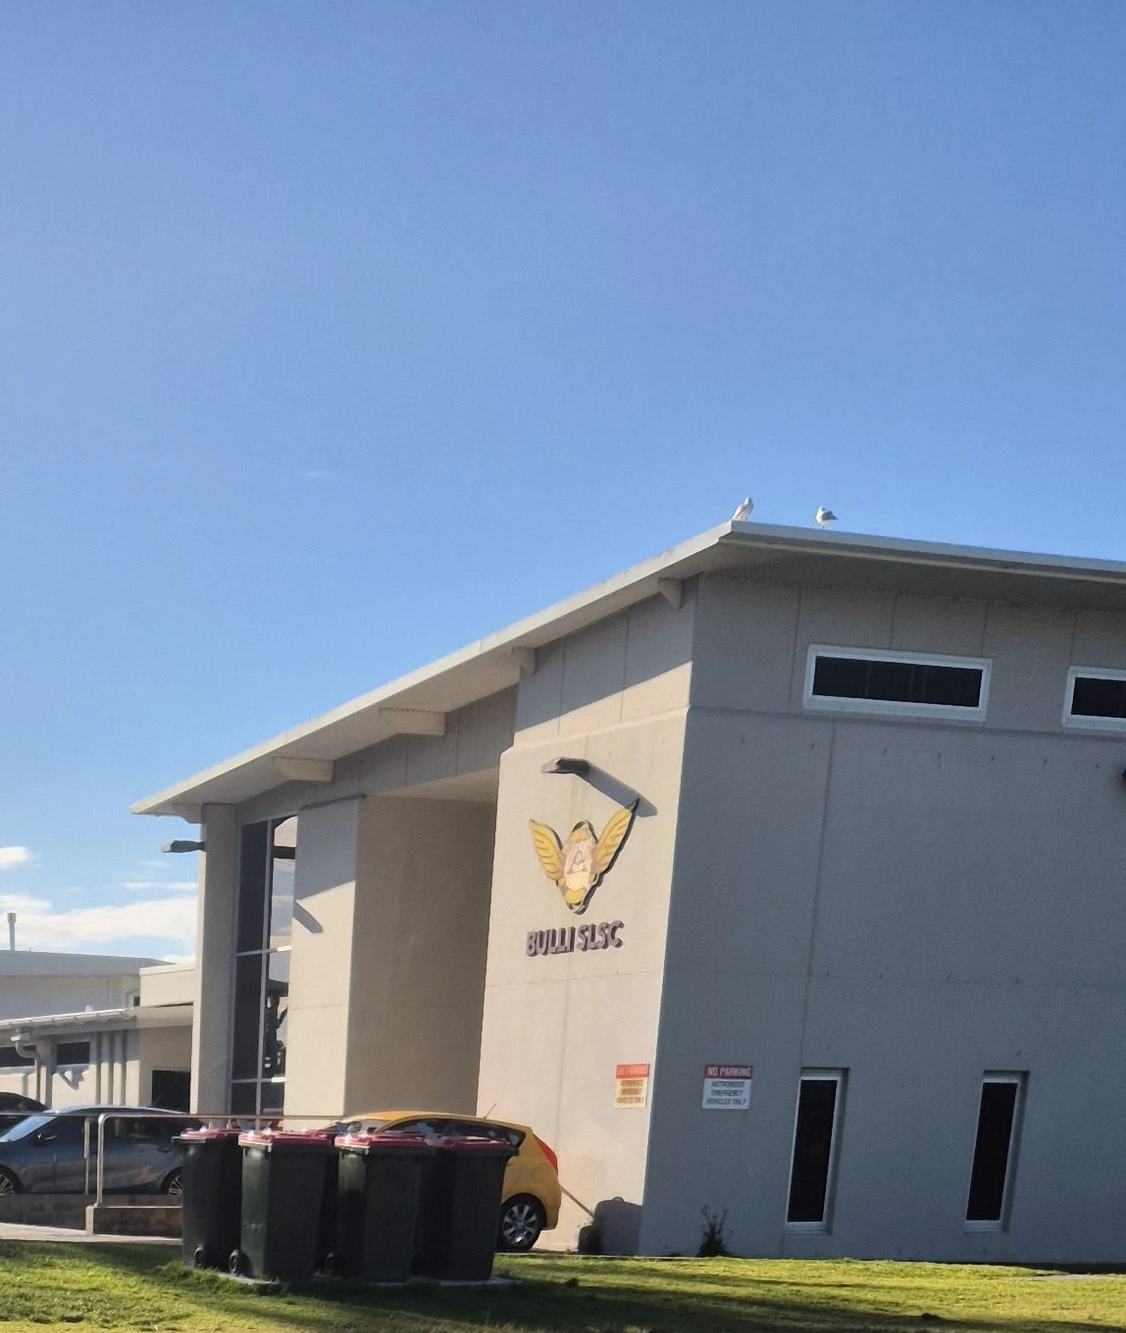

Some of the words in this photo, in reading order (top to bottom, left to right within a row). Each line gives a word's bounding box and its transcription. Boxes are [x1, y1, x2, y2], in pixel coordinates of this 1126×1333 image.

[526, 926, 576, 957] BULLI
[577, 920, 624, 951] SLSC
[707, 1066, 718, 1076] NO
[719, 1066, 751, 1077] PARKING
